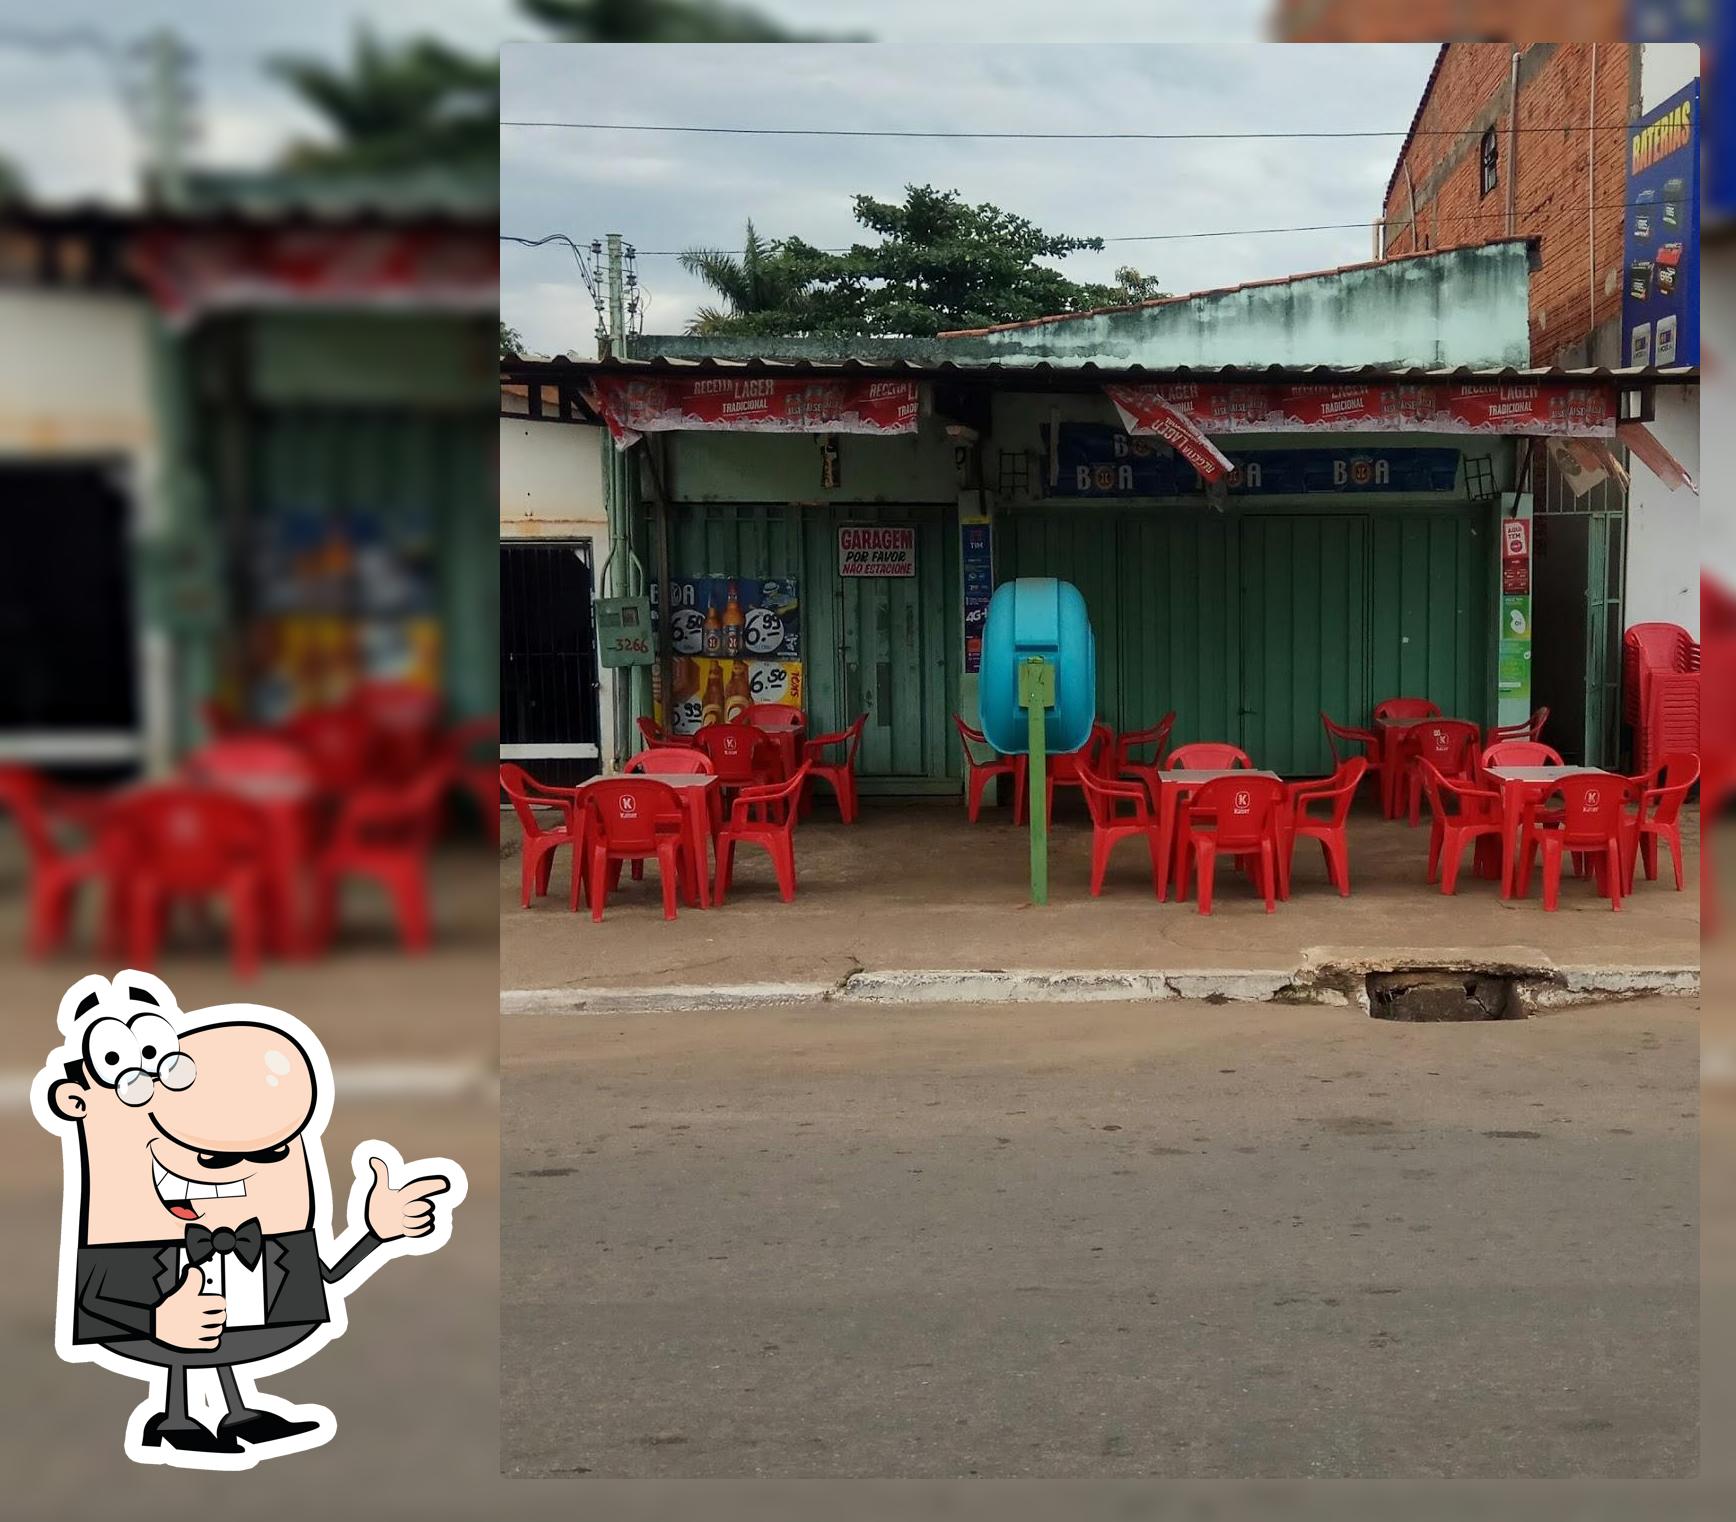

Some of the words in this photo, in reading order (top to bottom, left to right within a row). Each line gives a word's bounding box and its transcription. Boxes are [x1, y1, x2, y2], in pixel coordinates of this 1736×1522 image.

[1632, 101, 1691, 176] BATERIAS
[722, 398, 768, 413] TRADICIONAL
[1320, 398, 1365, 414] TRADICIONAL
[1488, 402, 1532, 416] TRADICIONAL
[842, 530, 913, 550] GARAGEM
[846, 551, 869, 563] POR
[872, 551, 906, 562] FAVOR
[865, 563, 913, 574] ESTACIONE
[744, 613, 781, 645] 6.99
[616, 638, 648, 653] 3266
[751, 669, 787, 693] 6.50
